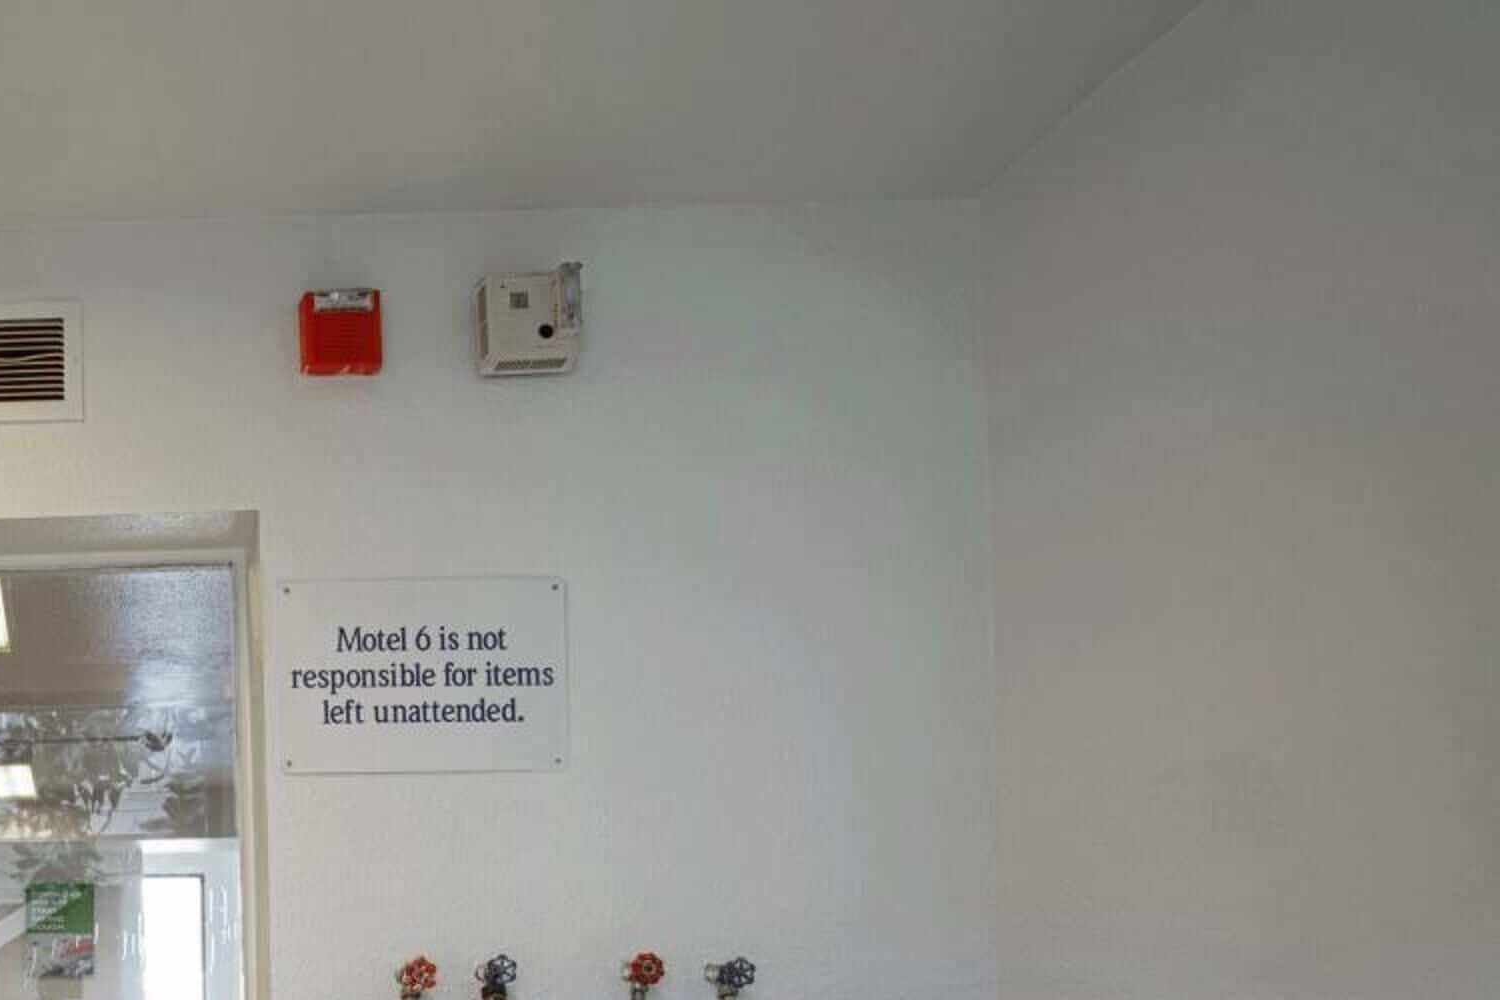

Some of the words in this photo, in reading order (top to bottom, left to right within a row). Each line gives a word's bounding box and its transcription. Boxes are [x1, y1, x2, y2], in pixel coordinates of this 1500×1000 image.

[336, 626, 407, 652] Motel
[415, 626, 431, 651] 6
[439, 626, 459, 651] is
[468, 628, 507, 650] not
[291, 662, 436, 694] responsible
[443, 662, 477, 688] for
[485, 661, 554, 687] items
[323, 699, 363, 725] left
[374, 697, 525, 724] unattended.
